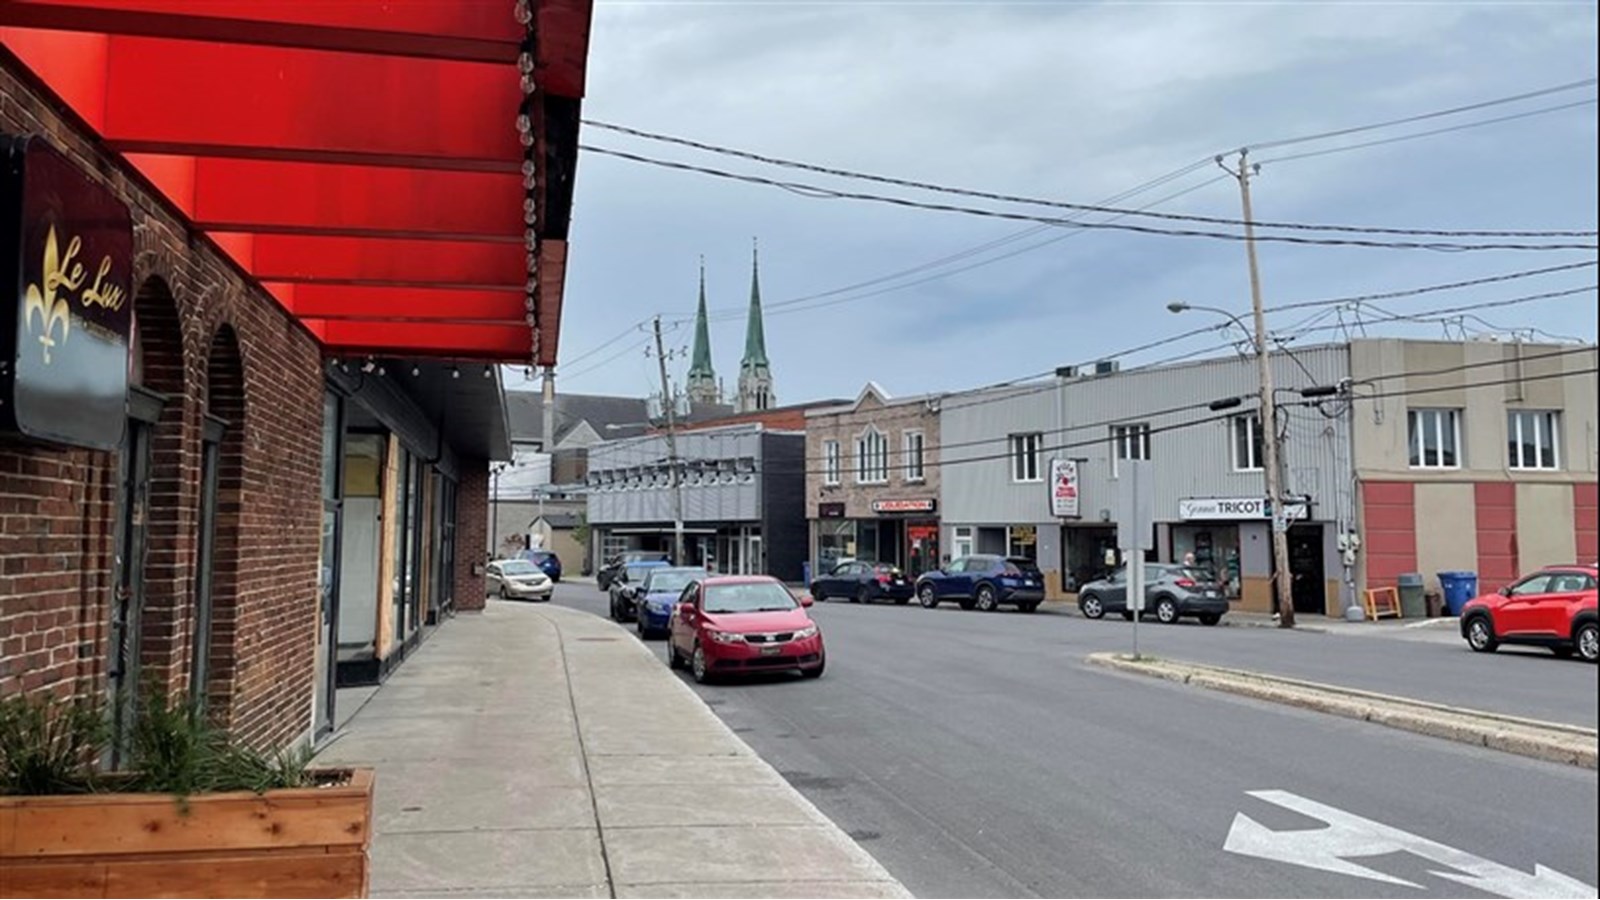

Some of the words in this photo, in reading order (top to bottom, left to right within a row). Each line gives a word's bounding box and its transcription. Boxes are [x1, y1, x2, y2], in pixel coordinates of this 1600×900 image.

[48, 235, 86, 290] Le
[82, 255, 127, 312] Lux
[1217, 501, 1261, 514] TRICOT
